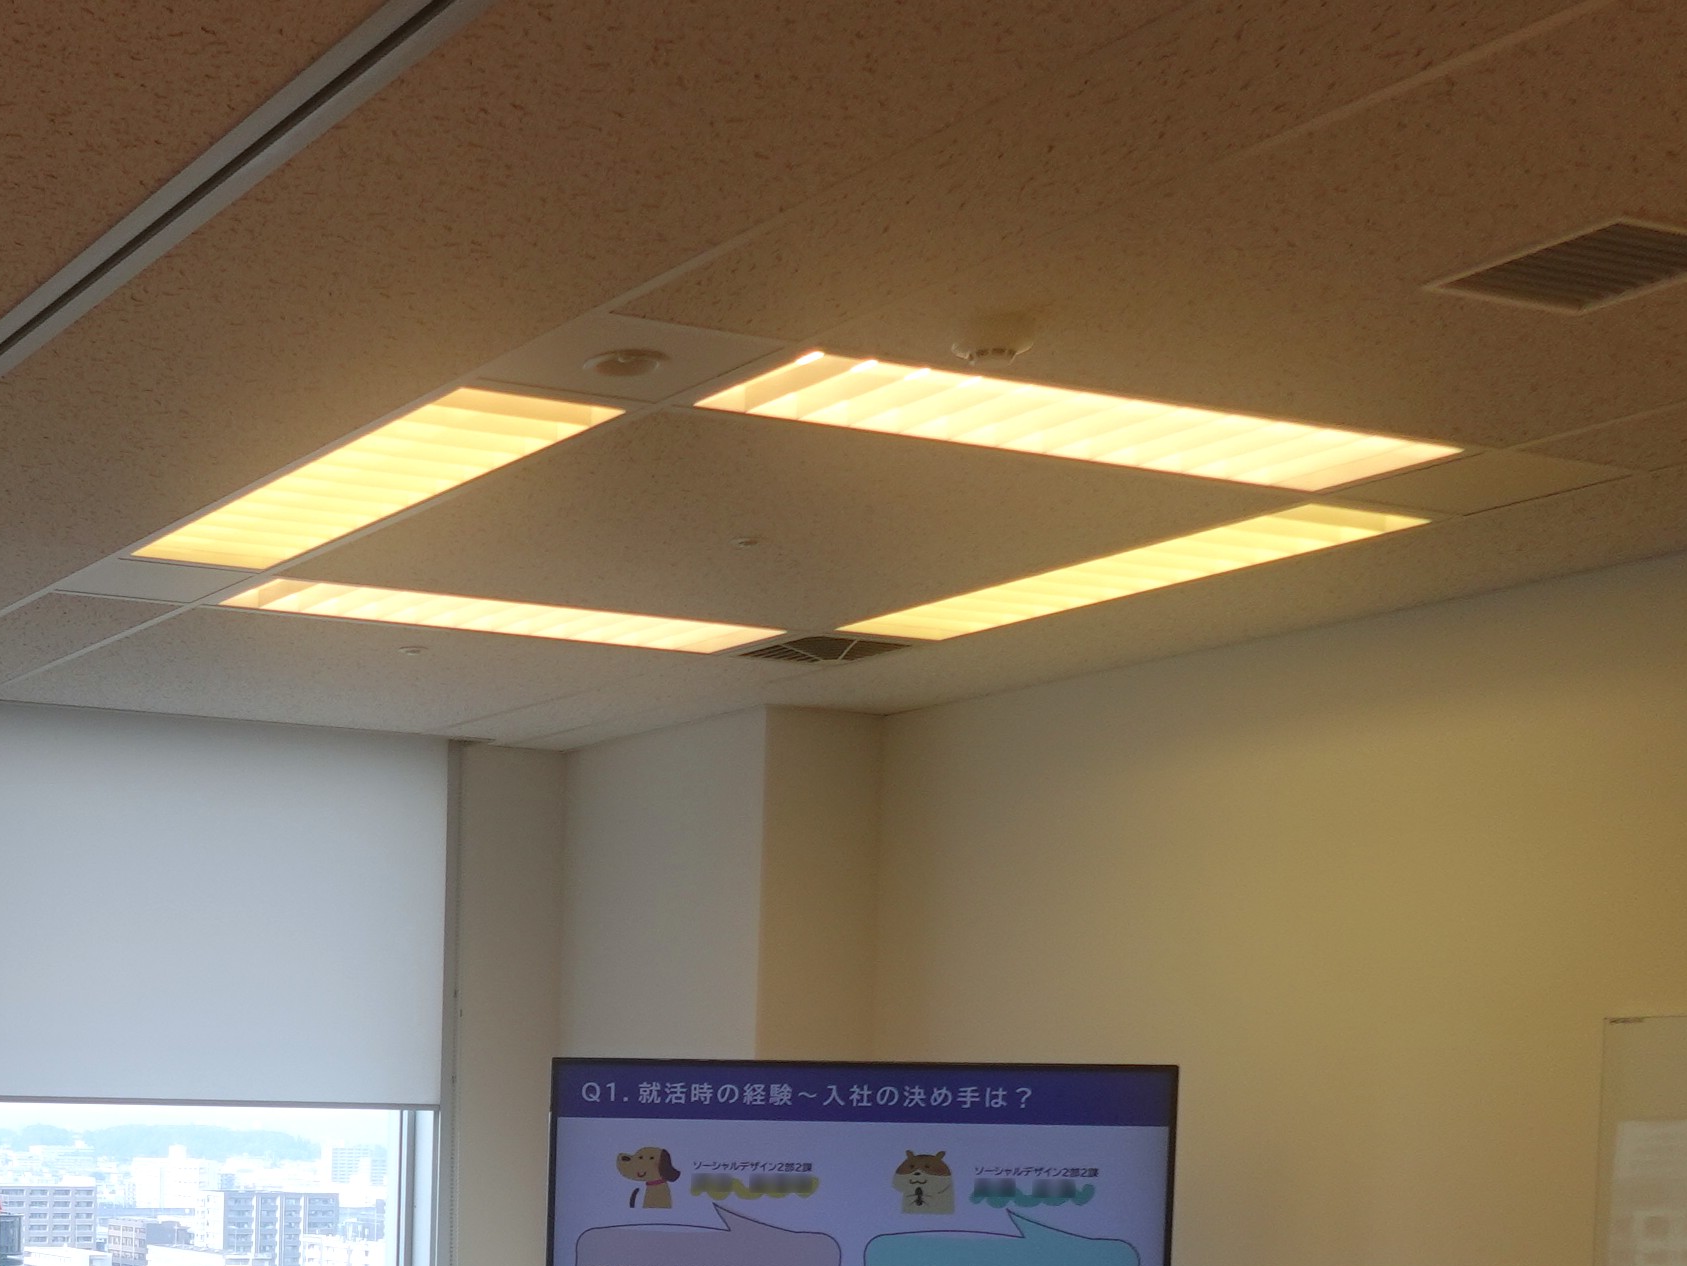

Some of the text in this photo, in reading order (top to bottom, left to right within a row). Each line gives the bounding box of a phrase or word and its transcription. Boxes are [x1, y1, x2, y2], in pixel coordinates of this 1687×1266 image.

[692, 1160, 813, 1173] ソーシャルデザイン2部2課
[974, 1166, 1099, 1178] ソーシャルデザイン2部2課
